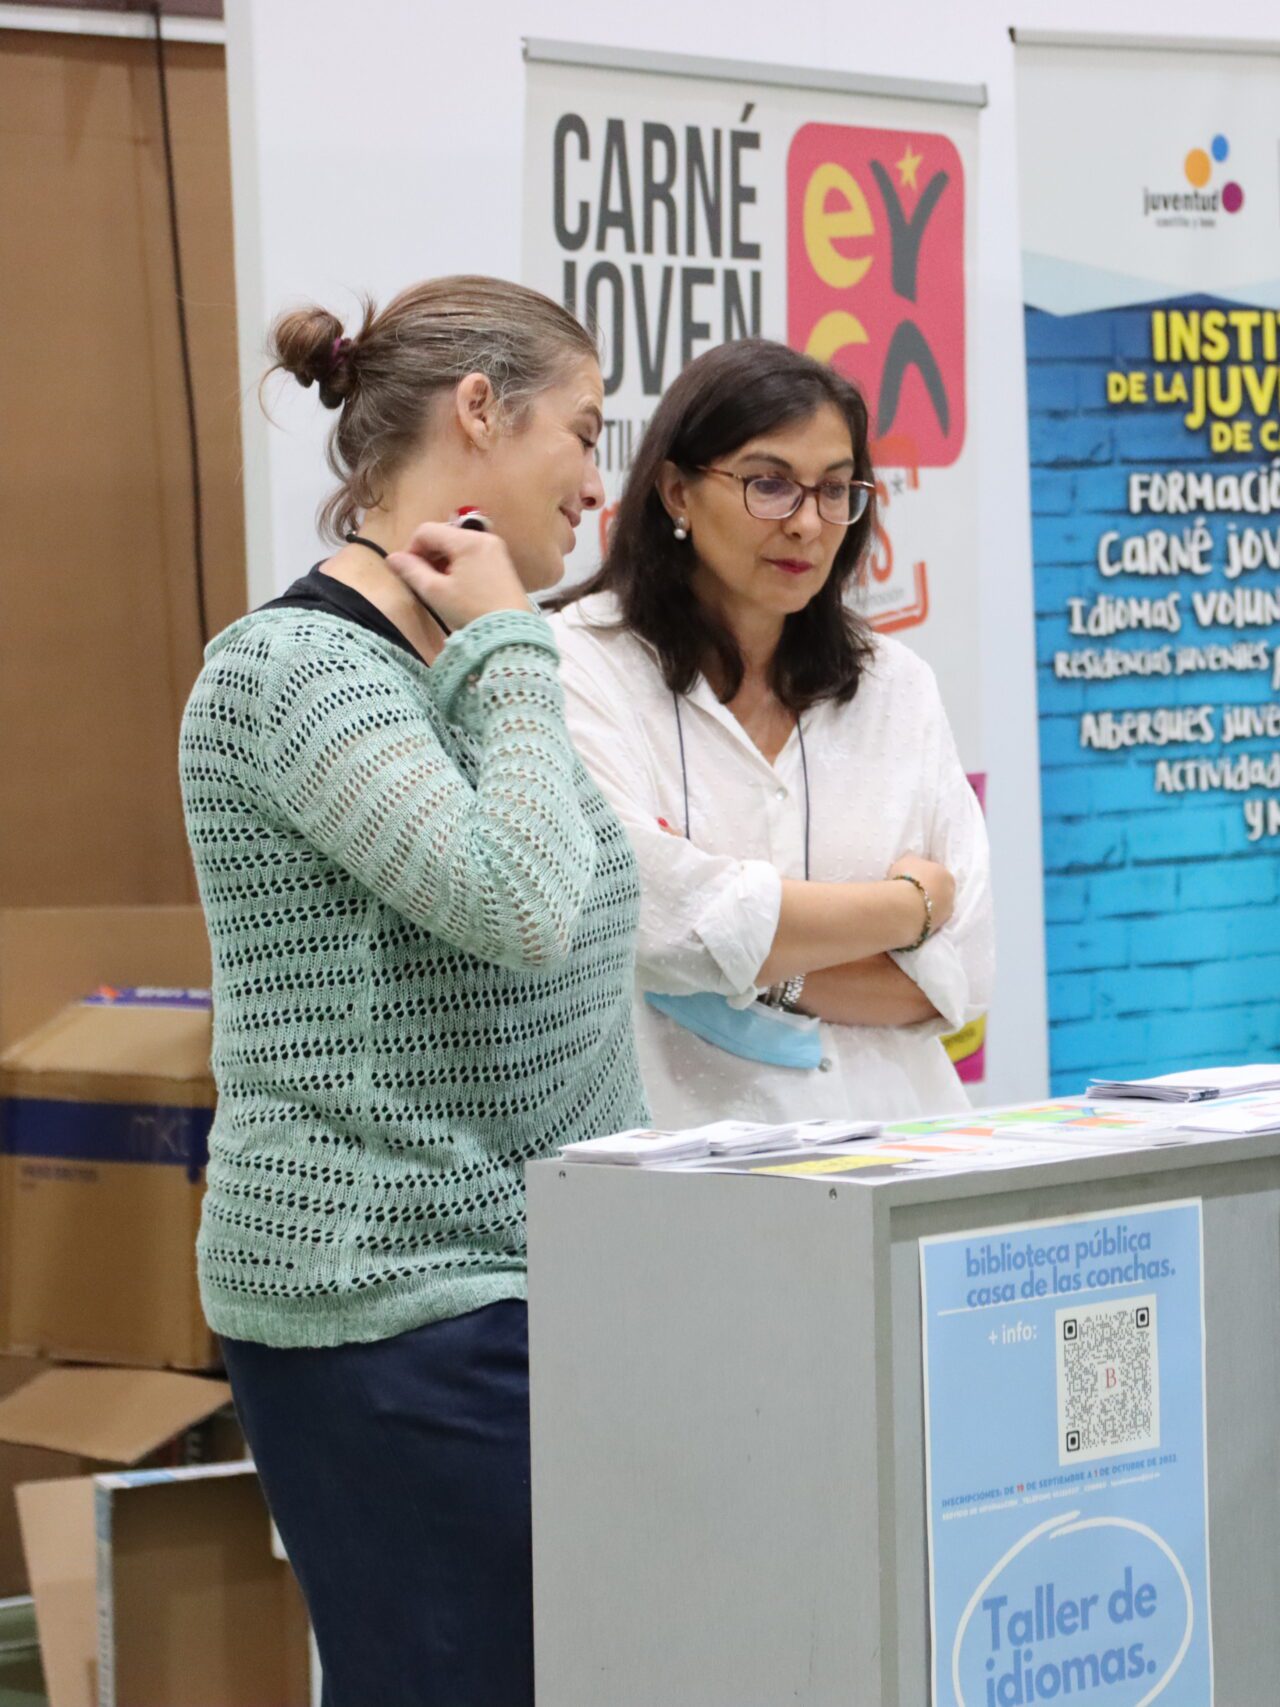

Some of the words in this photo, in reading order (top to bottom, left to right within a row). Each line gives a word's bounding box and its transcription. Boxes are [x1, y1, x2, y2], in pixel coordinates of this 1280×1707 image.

[553, 102, 761, 260] CARNÉ
[1143, 187, 1221, 217] juventud
[1107, 372, 1148, 403] DE
[1154, 371, 1188, 403] LA
[1211, 421, 1253, 453] DE
[965, 1241, 1070, 1279] biblioteca
[1075, 1226, 1152, 1269] pública
[966, 1283, 1016, 1308] casa
[1020, 1269, 1048, 1299] de
[1052, 1265, 1082, 1293] las
[1086, 1254, 1177, 1289] conchas.
[1002, 1323, 1038, 1345] info:
[1105, 1367, 1118, 1389] B
[982, 1582, 1100, 1651] Taller
[1107, 1565, 1158, 1625] de
[985, 1642, 1157, 1707] idiomas.
